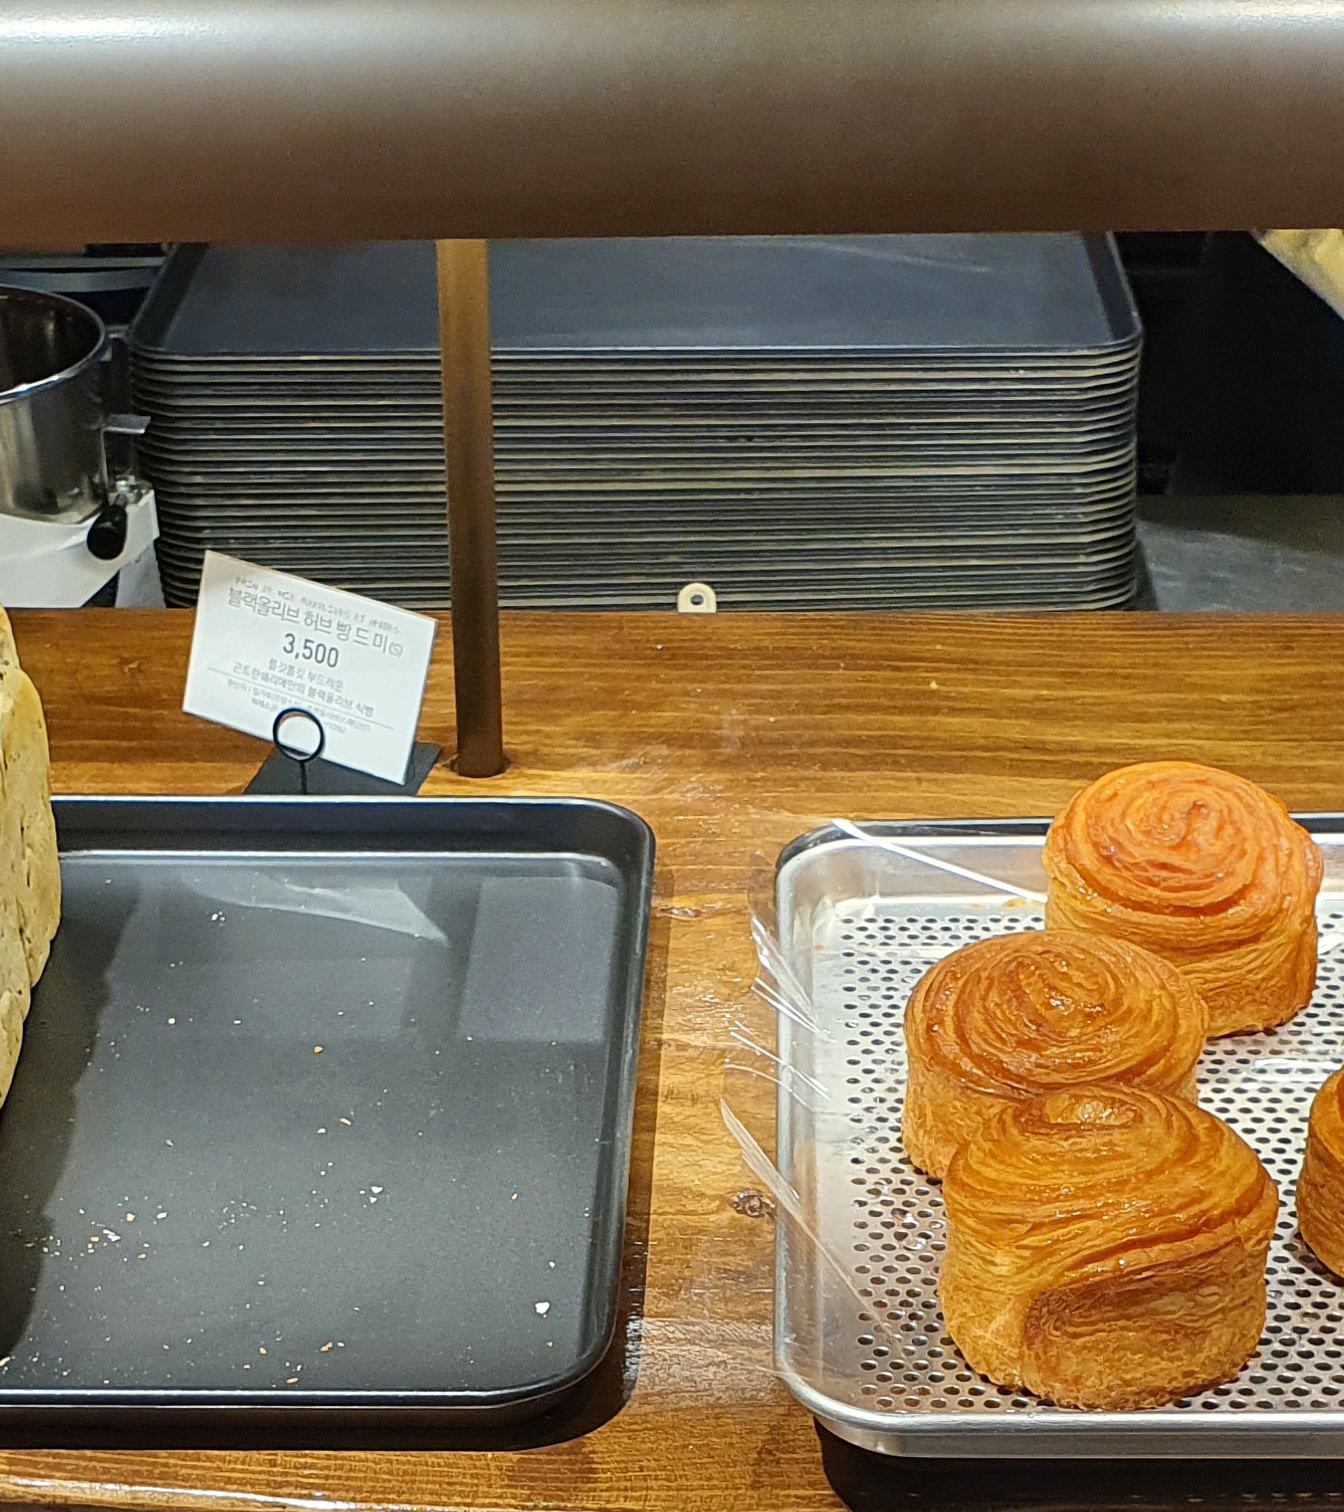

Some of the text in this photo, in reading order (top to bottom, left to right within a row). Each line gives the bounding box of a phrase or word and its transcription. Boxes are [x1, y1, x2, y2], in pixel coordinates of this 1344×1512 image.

[227, 586, 301, 624] 블랙올리브
[303, 610, 333, 635] 허브
[335, 620, 352, 642] 빵
[353, 627, 370, 646] 드
[282, 633, 340, 668] 3,500
